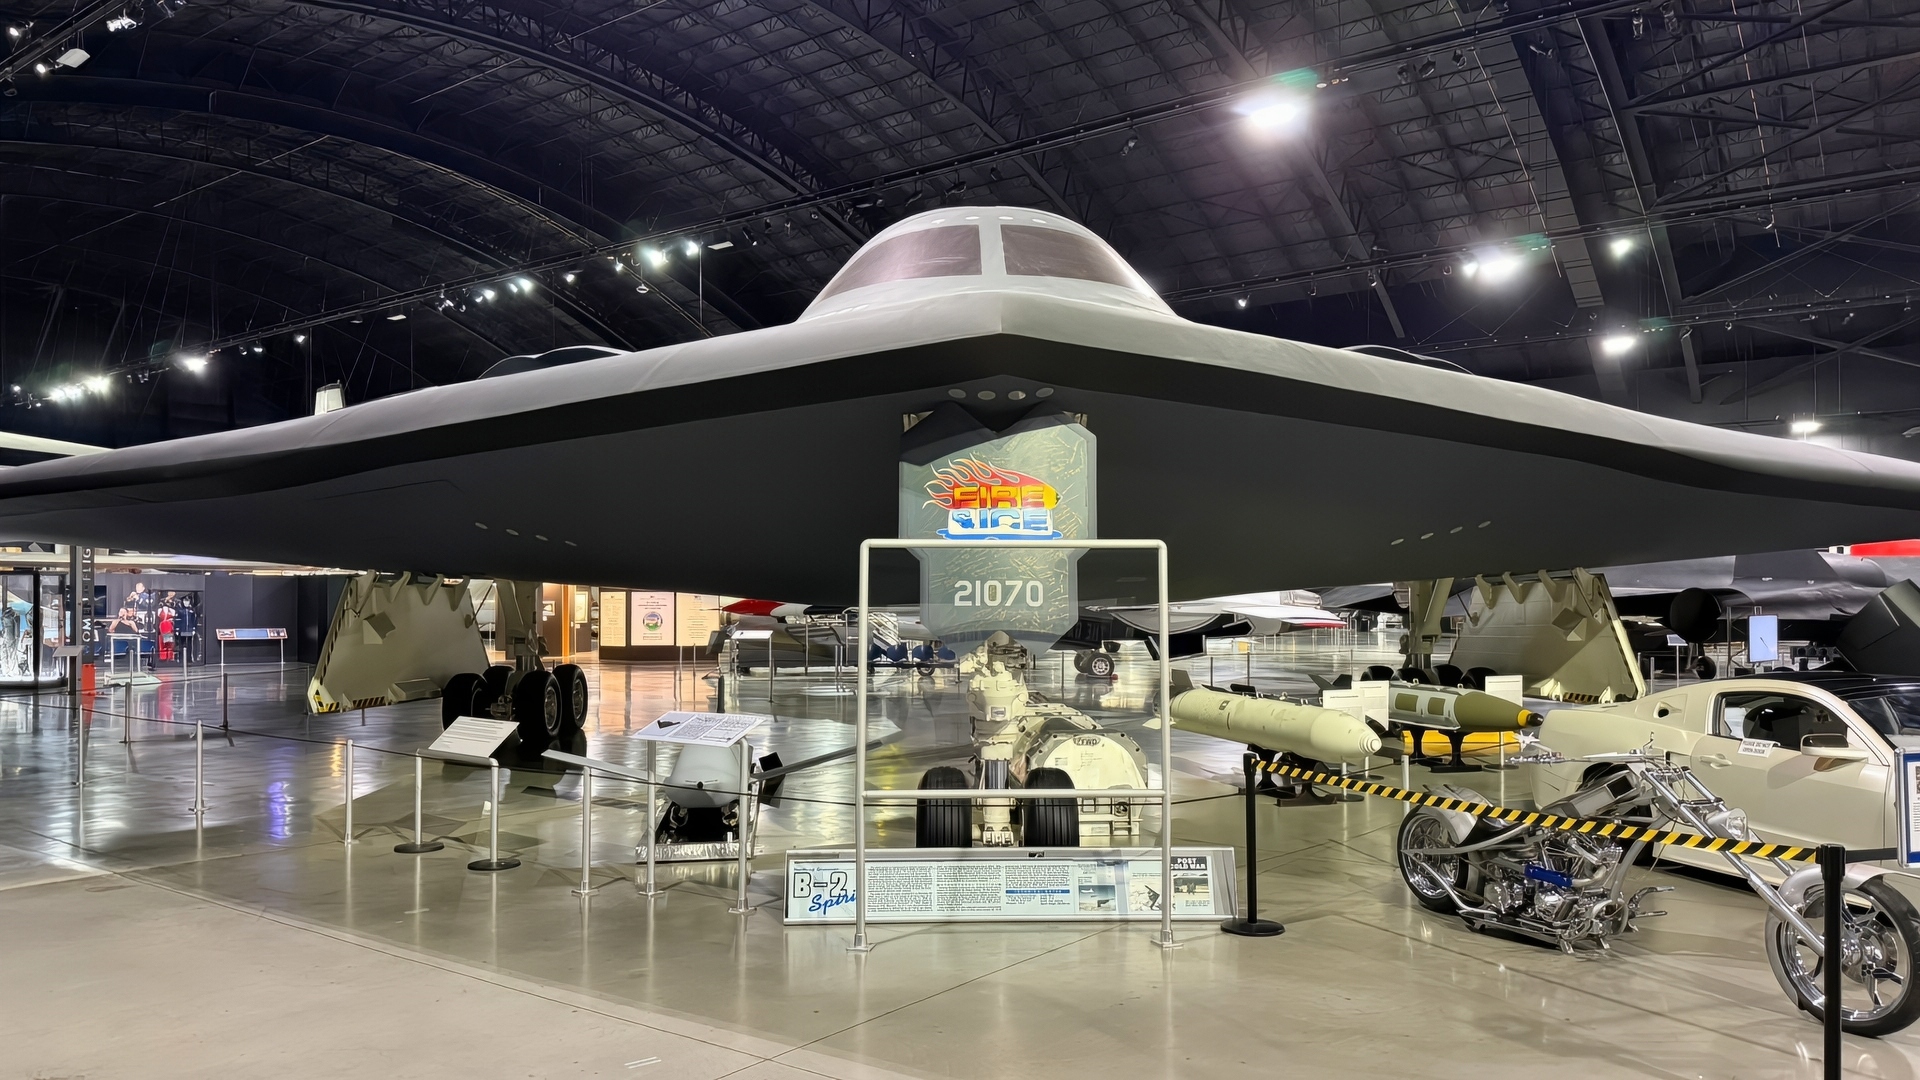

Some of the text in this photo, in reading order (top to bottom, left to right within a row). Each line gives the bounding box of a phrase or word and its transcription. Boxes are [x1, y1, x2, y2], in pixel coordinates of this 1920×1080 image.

[953, 485, 1045, 509] FIRE
[954, 580, 1044, 607] 21070
[793, 871, 848, 898] B-2
[808, 889, 857, 915] Spiri
